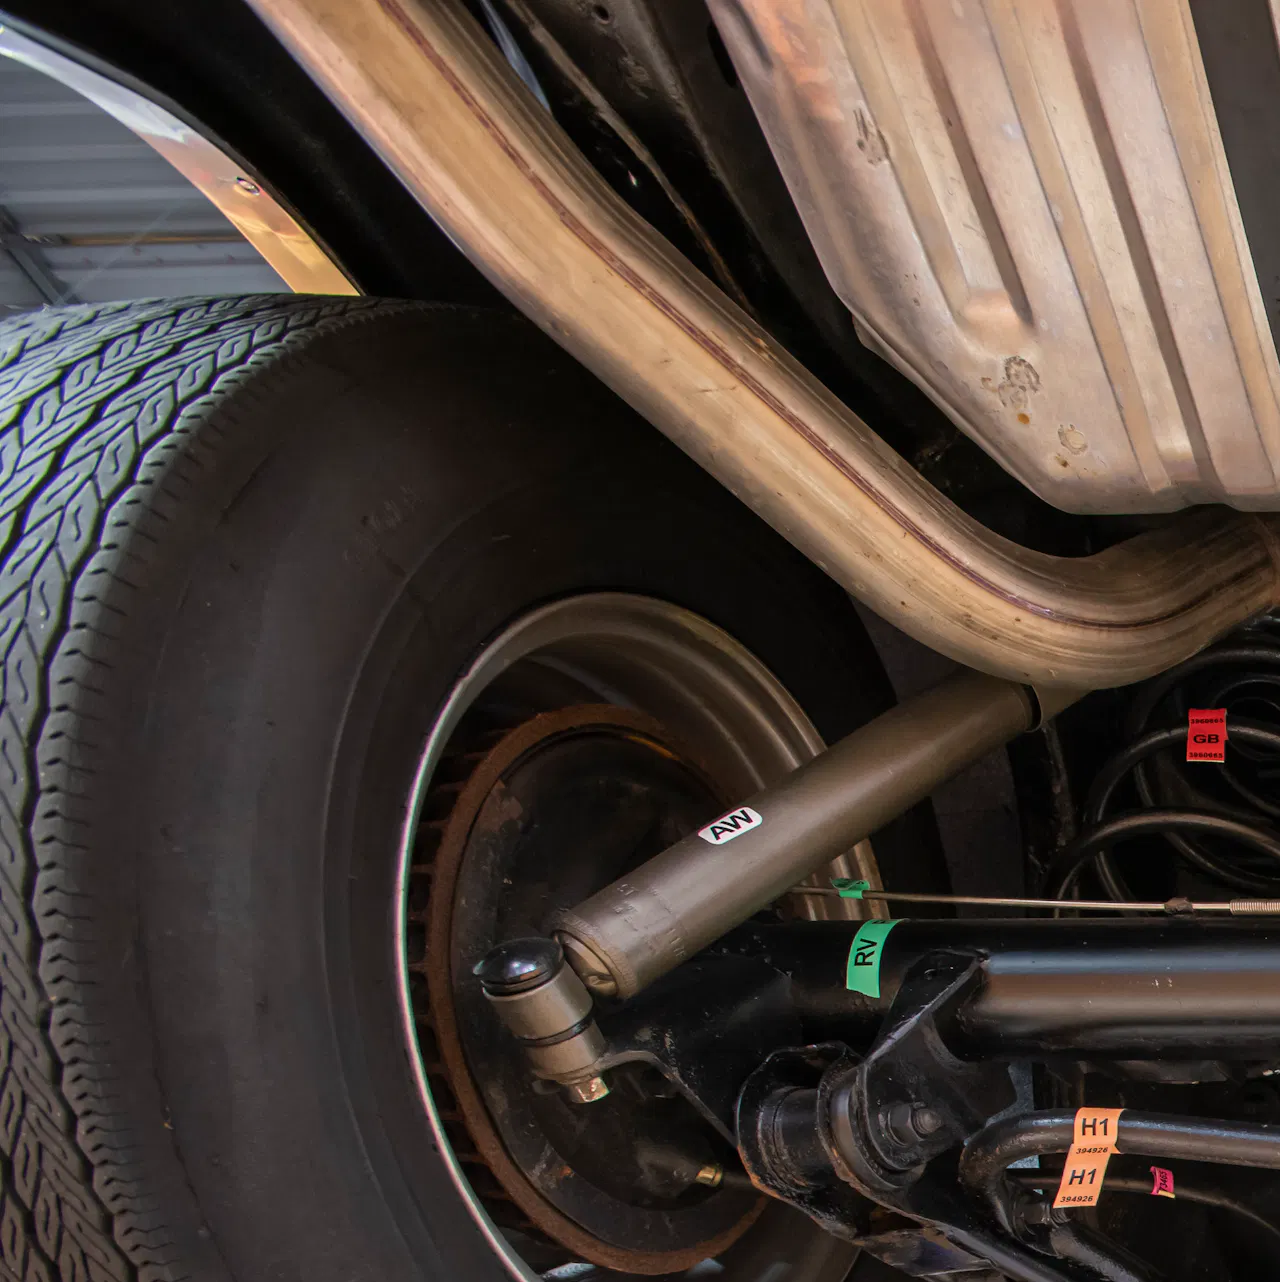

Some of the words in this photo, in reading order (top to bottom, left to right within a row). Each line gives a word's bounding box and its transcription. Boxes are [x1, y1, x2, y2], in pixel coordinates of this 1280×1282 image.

[1193, 734, 1219, 744] GB
[710, 809, 753, 841] AW
[854, 938, 877, 967] RV
[1081, 1118, 1108, 1136] H1
[1068, 1168, 1097, 1186] H1
